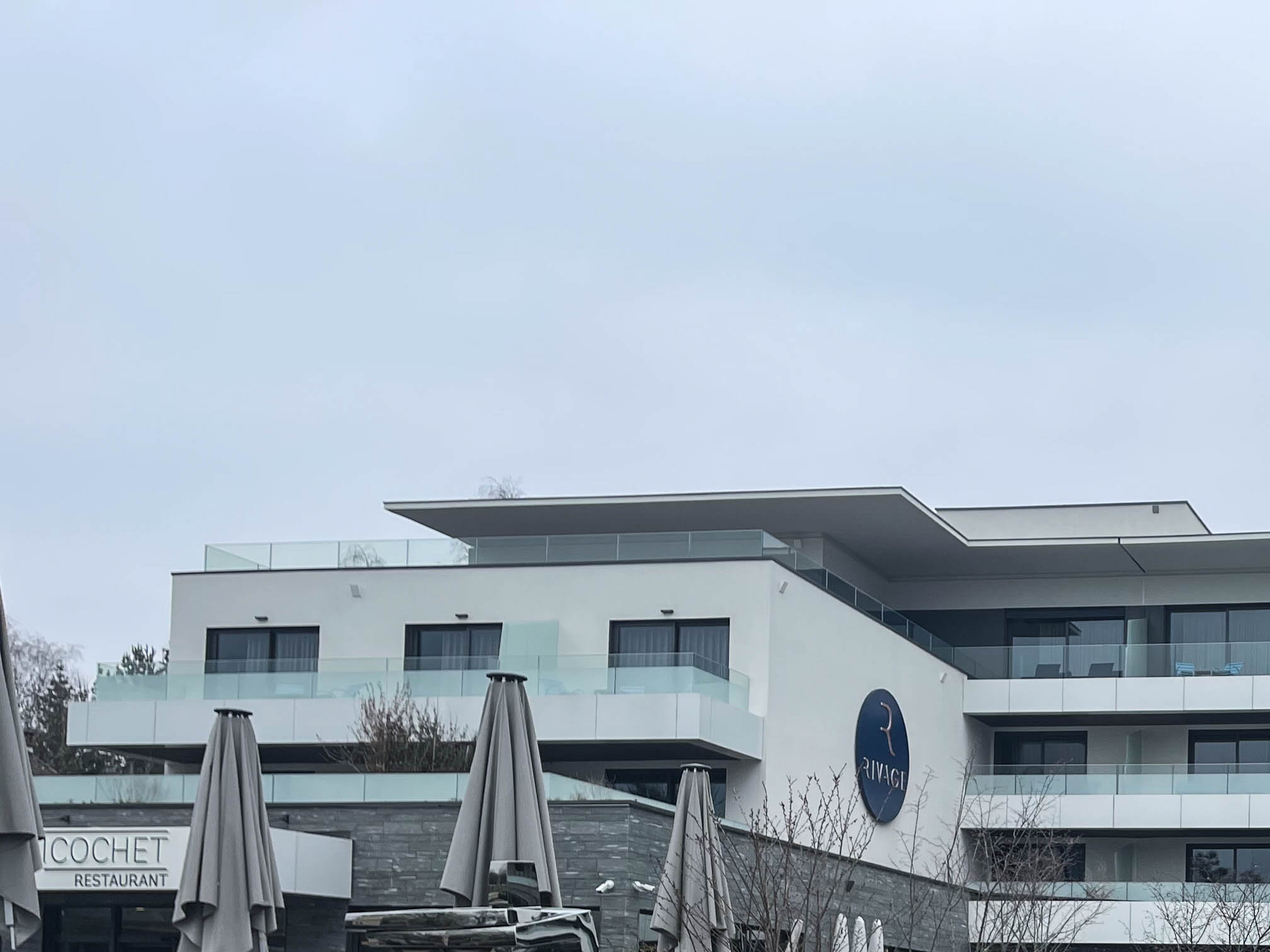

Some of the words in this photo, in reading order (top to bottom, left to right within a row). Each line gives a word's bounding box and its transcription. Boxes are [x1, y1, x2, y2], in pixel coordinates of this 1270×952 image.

[863, 756, 907, 791] RIVAGE
[42, 836, 169, 864] ICOCHET
[74, 873, 168, 888] RESTAURANT
